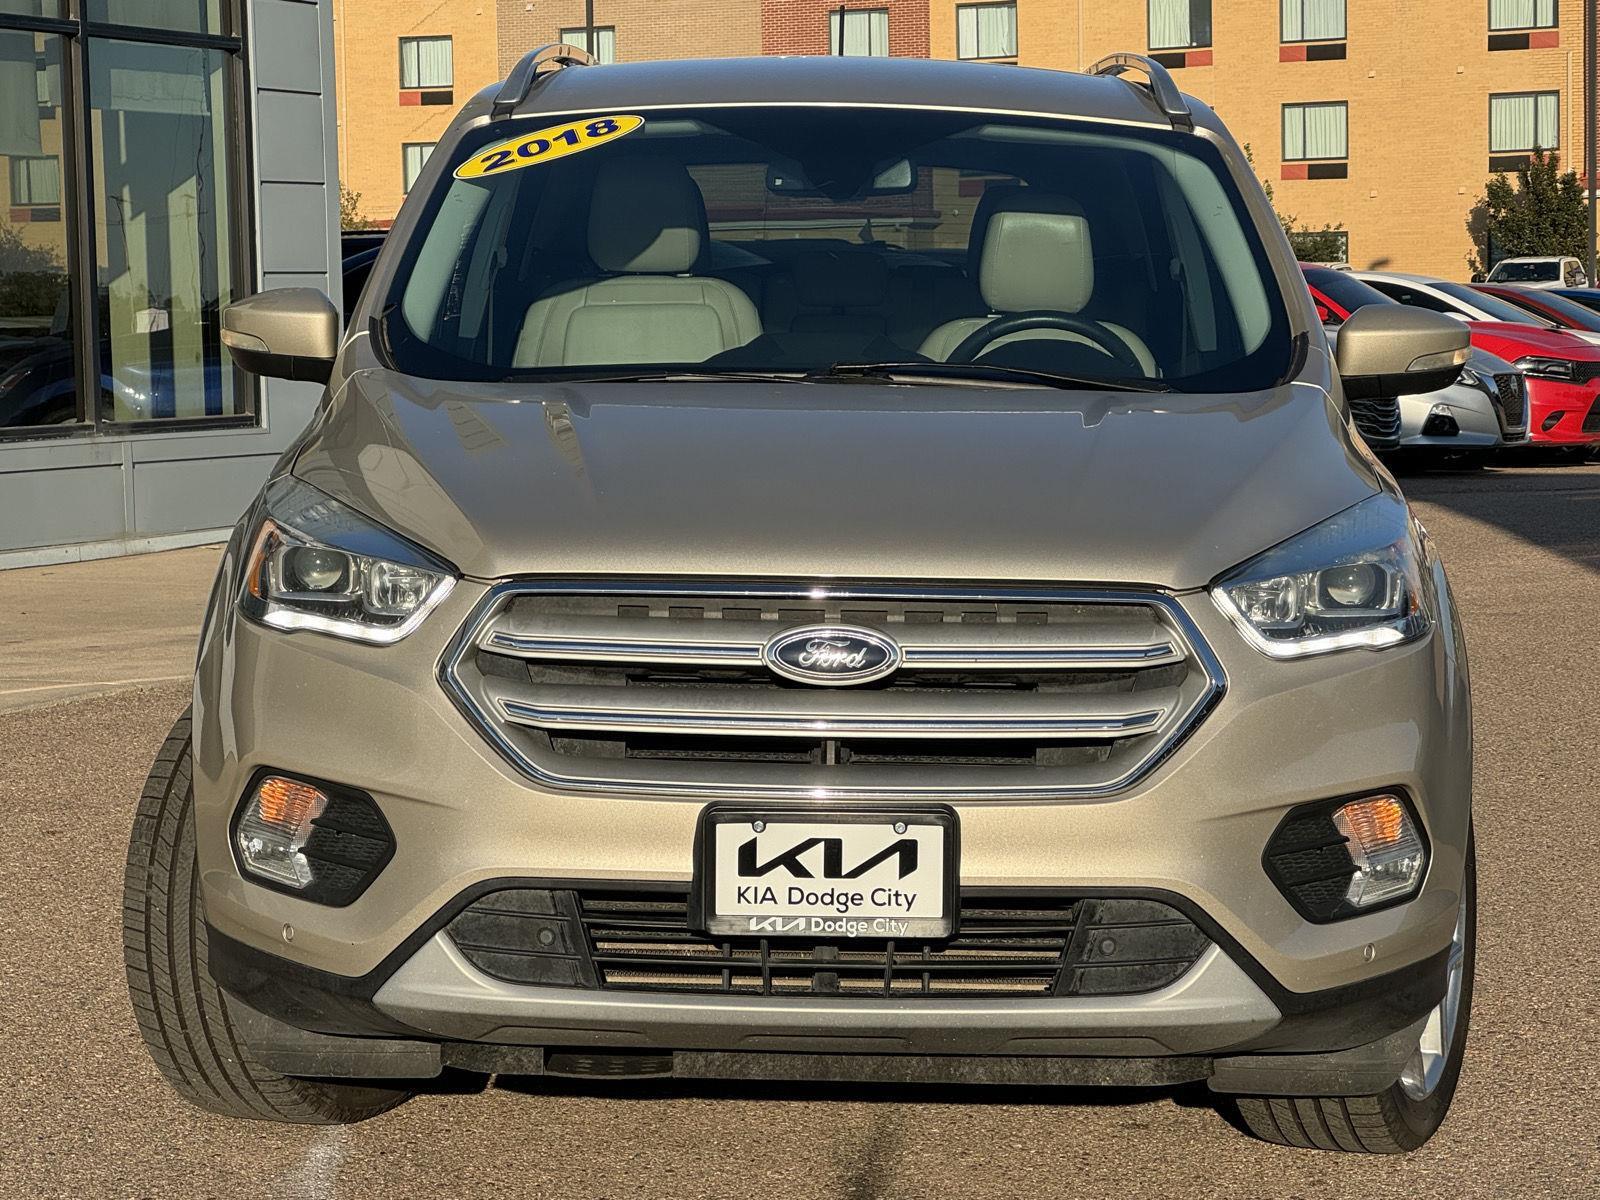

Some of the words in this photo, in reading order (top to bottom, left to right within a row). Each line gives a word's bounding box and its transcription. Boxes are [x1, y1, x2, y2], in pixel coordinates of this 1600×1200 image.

[480, 119, 622, 173] 2018
[799, 638, 868, 668] Ford
[738, 836, 918, 880] KIA
[737, 886, 778, 905] KIA
[788, 887, 864, 913] Dodge
[871, 887, 917, 912] City
[750, 916, 805, 931] KIA
[811, 917, 868, 937] Dodge
[873, 918, 909, 936] City
